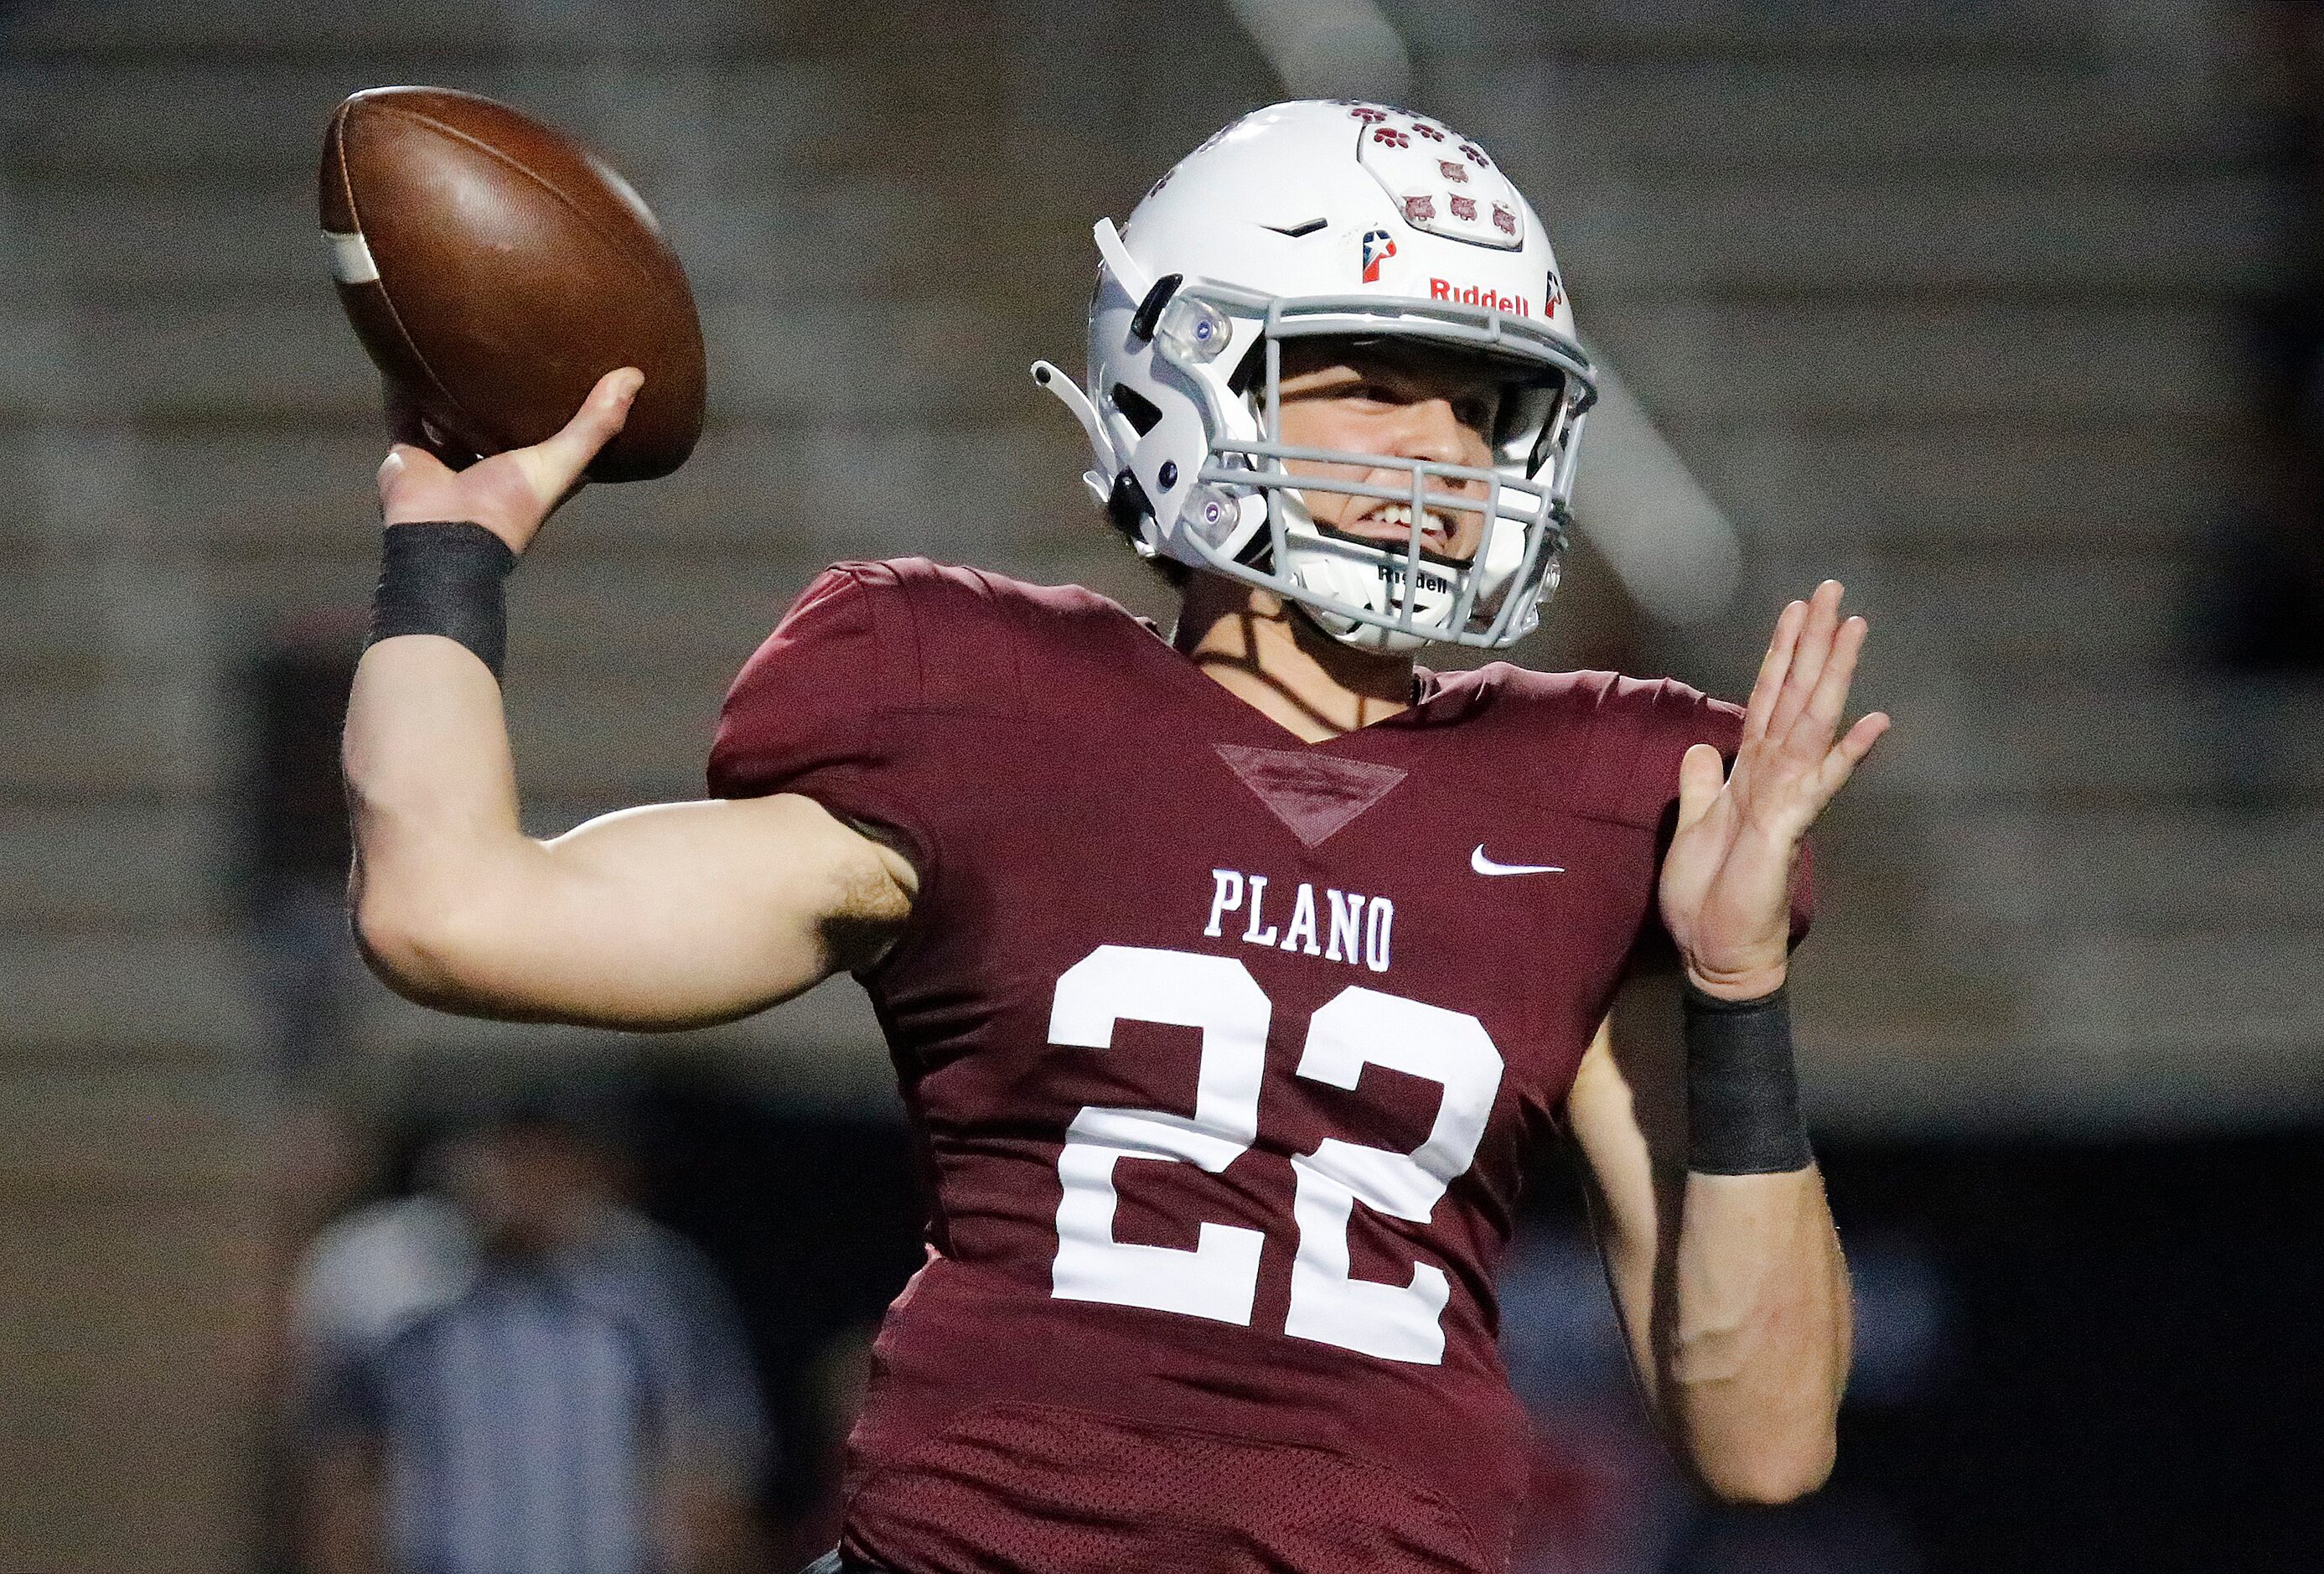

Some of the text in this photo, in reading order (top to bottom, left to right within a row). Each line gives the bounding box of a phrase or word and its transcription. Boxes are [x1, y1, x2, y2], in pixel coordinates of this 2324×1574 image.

[1430, 277, 1528, 318] Riddell
[1378, 565, 1447, 594] Ridell
[1203, 868, 1395, 972] PLANO
[1047, 945, 1504, 1365] 22
